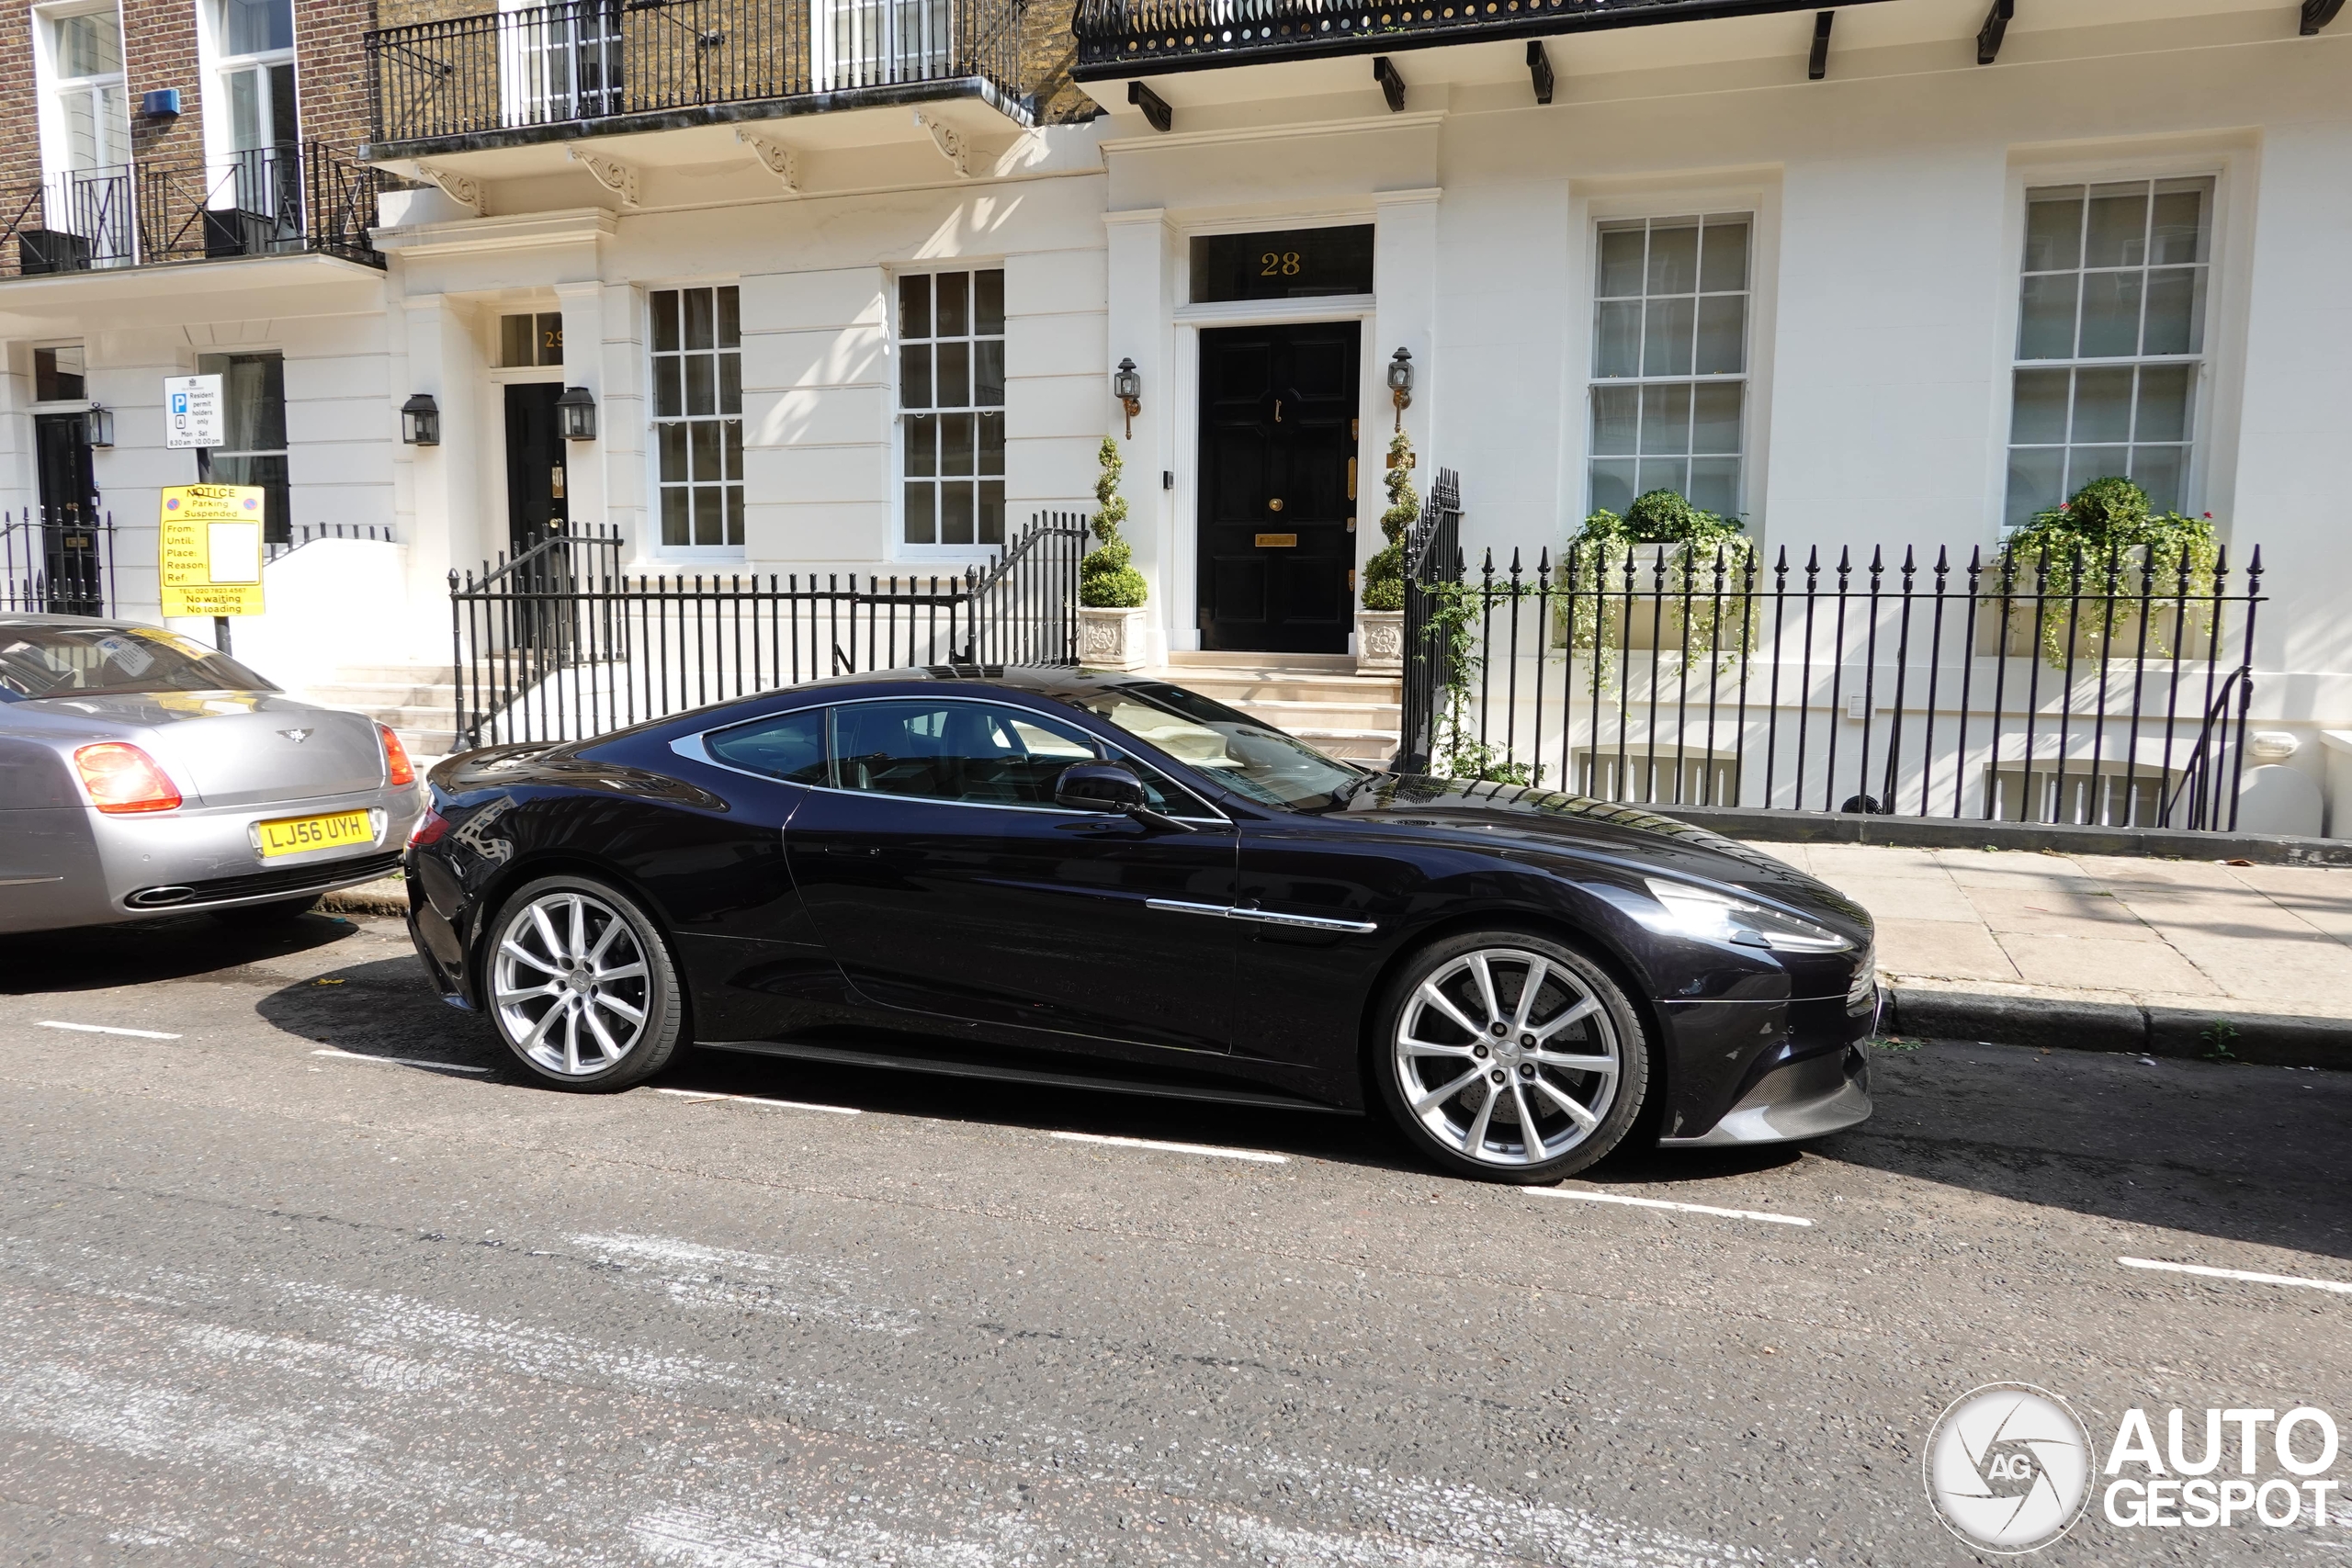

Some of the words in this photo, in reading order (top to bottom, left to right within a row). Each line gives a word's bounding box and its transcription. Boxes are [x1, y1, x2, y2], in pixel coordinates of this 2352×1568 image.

[1261, 252, 1301, 276] 28
[187, 487, 236, 498] NOTICE
[192, 500, 229, 508] Parking
[184, 510, 238, 518] Suspended
[203, 595, 241, 604] waiting
[204, 605, 242, 615] loading
[268, 821, 322, 848] LJ56
[325, 816, 362, 839] UYH
